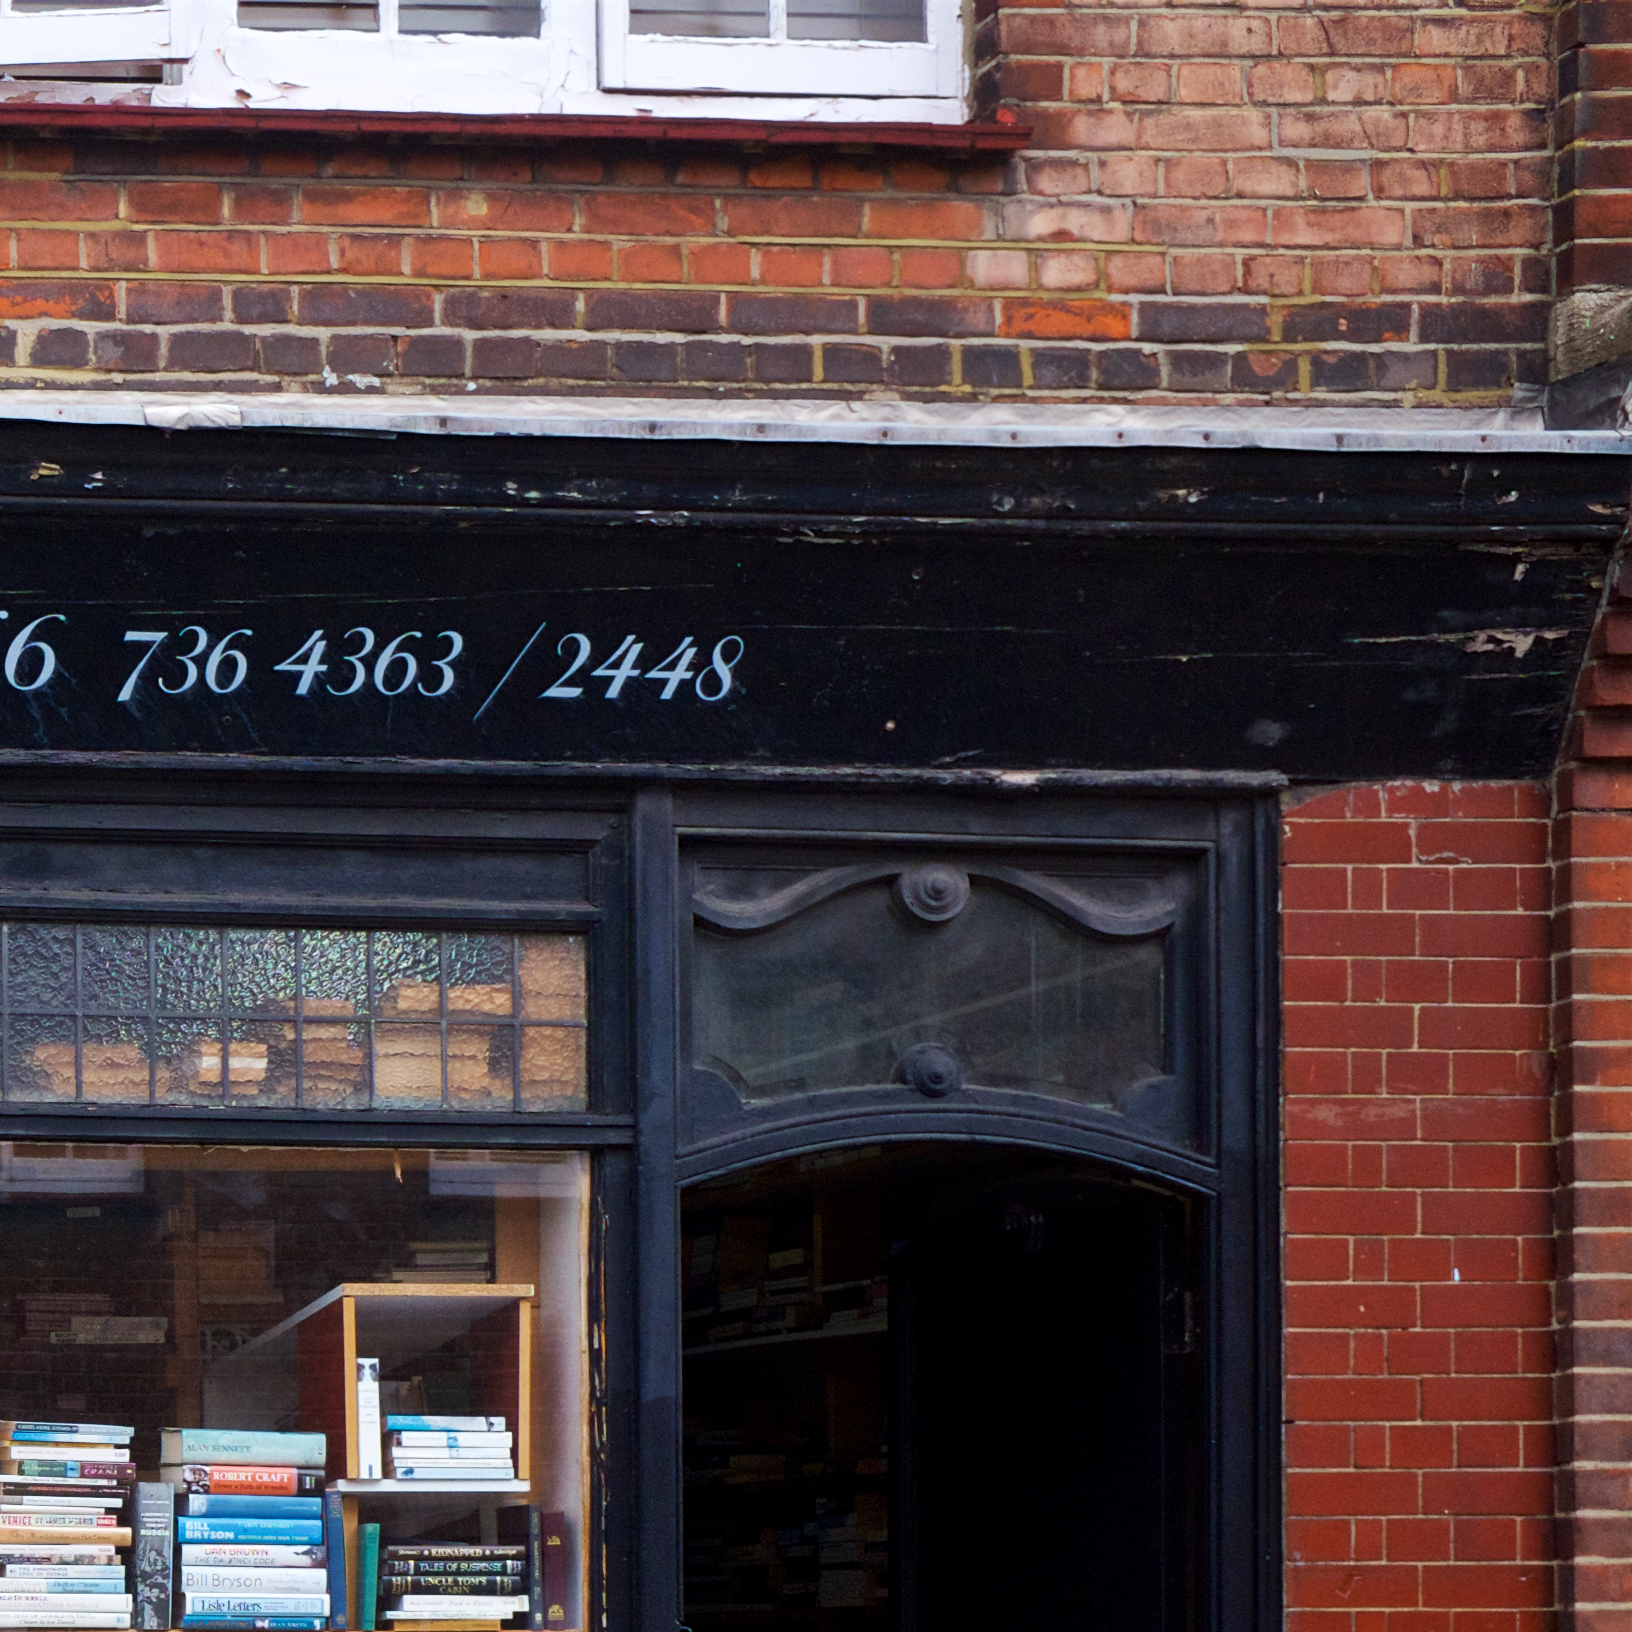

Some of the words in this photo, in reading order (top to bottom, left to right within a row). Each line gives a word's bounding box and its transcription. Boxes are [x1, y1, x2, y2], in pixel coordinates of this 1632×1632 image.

[120, 625, 253, 703] 736
[274, 625, 463, 700] 4363
[185, 1444, 209, 1453] ALAN
[211, 1444, 251, 1453] BENNETT
[213, 1471, 251, 1482] ROBERT
[254, 1473, 289, 1483] CRAFT
[1, 1515, 33, 1526] VENICE
[185, 1521, 210, 1531] BILL
[185, 1530, 234, 1540] BRYSON
[204, 1546, 223, 1556] DAN
[225, 1547, 269, 1556] BROWN
[430, 1548, 483, 1557] KIDNAPPED
[419, 1562, 444, 1572] TALES
[446, 1562, 457, 1571] OF
[458, 1562, 503, 1571] SUSPENSE
[186, 1573, 209, 1587] Bill
[211, 1574, 263, 1591] Bryson
[420, 1577, 451, 1586] UNCLE
[454, 1577, 487, 1586] TOM'S
[439, 1586, 471, 1595] CABIN
